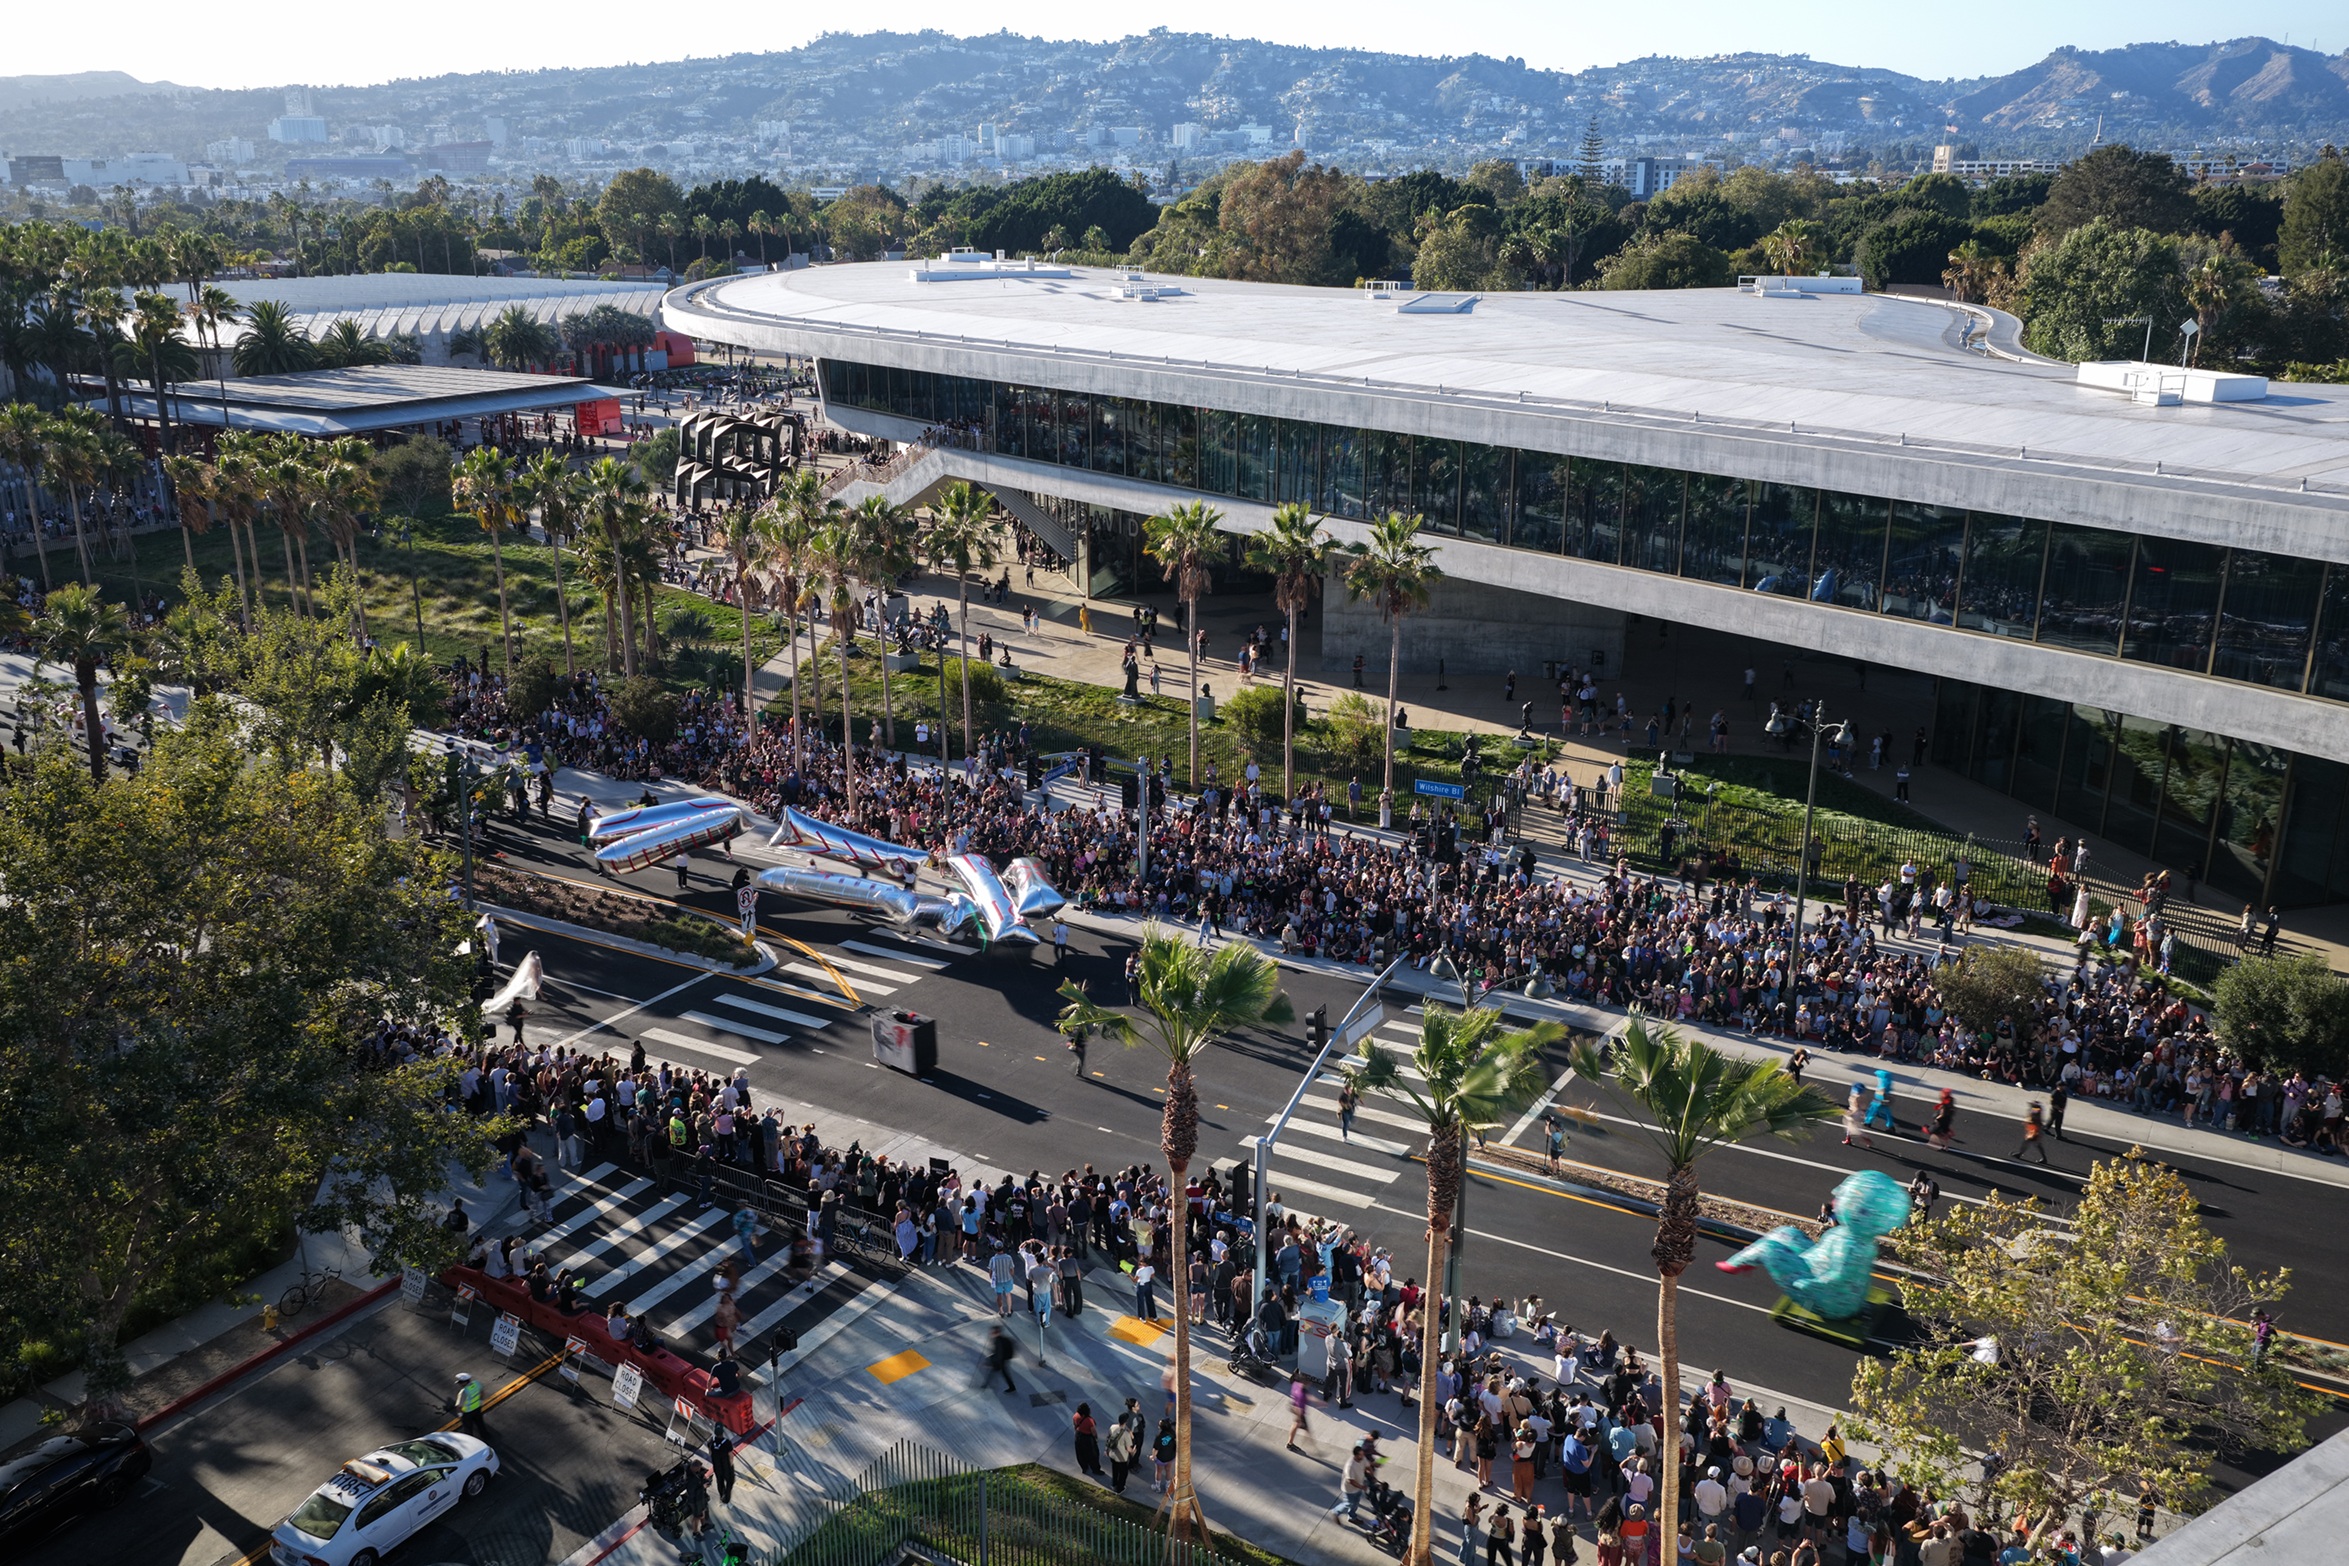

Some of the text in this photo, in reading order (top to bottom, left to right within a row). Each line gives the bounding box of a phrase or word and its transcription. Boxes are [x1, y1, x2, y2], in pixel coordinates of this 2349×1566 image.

[1077, 506, 1139, 537] DAVID
[1419, 783, 1460, 795] Wilshire Bl
[407, 1270, 423, 1284] ROAD
[402, 1279, 423, 1296] CLOSED
[498, 1323, 515, 1337] ROAD
[492, 1332, 515, 1349] CLOSED
[620, 1370, 637, 1386] ROAD
[614, 1380, 637, 1400] CLOSED
[327, 1473, 375, 1499] 01857
